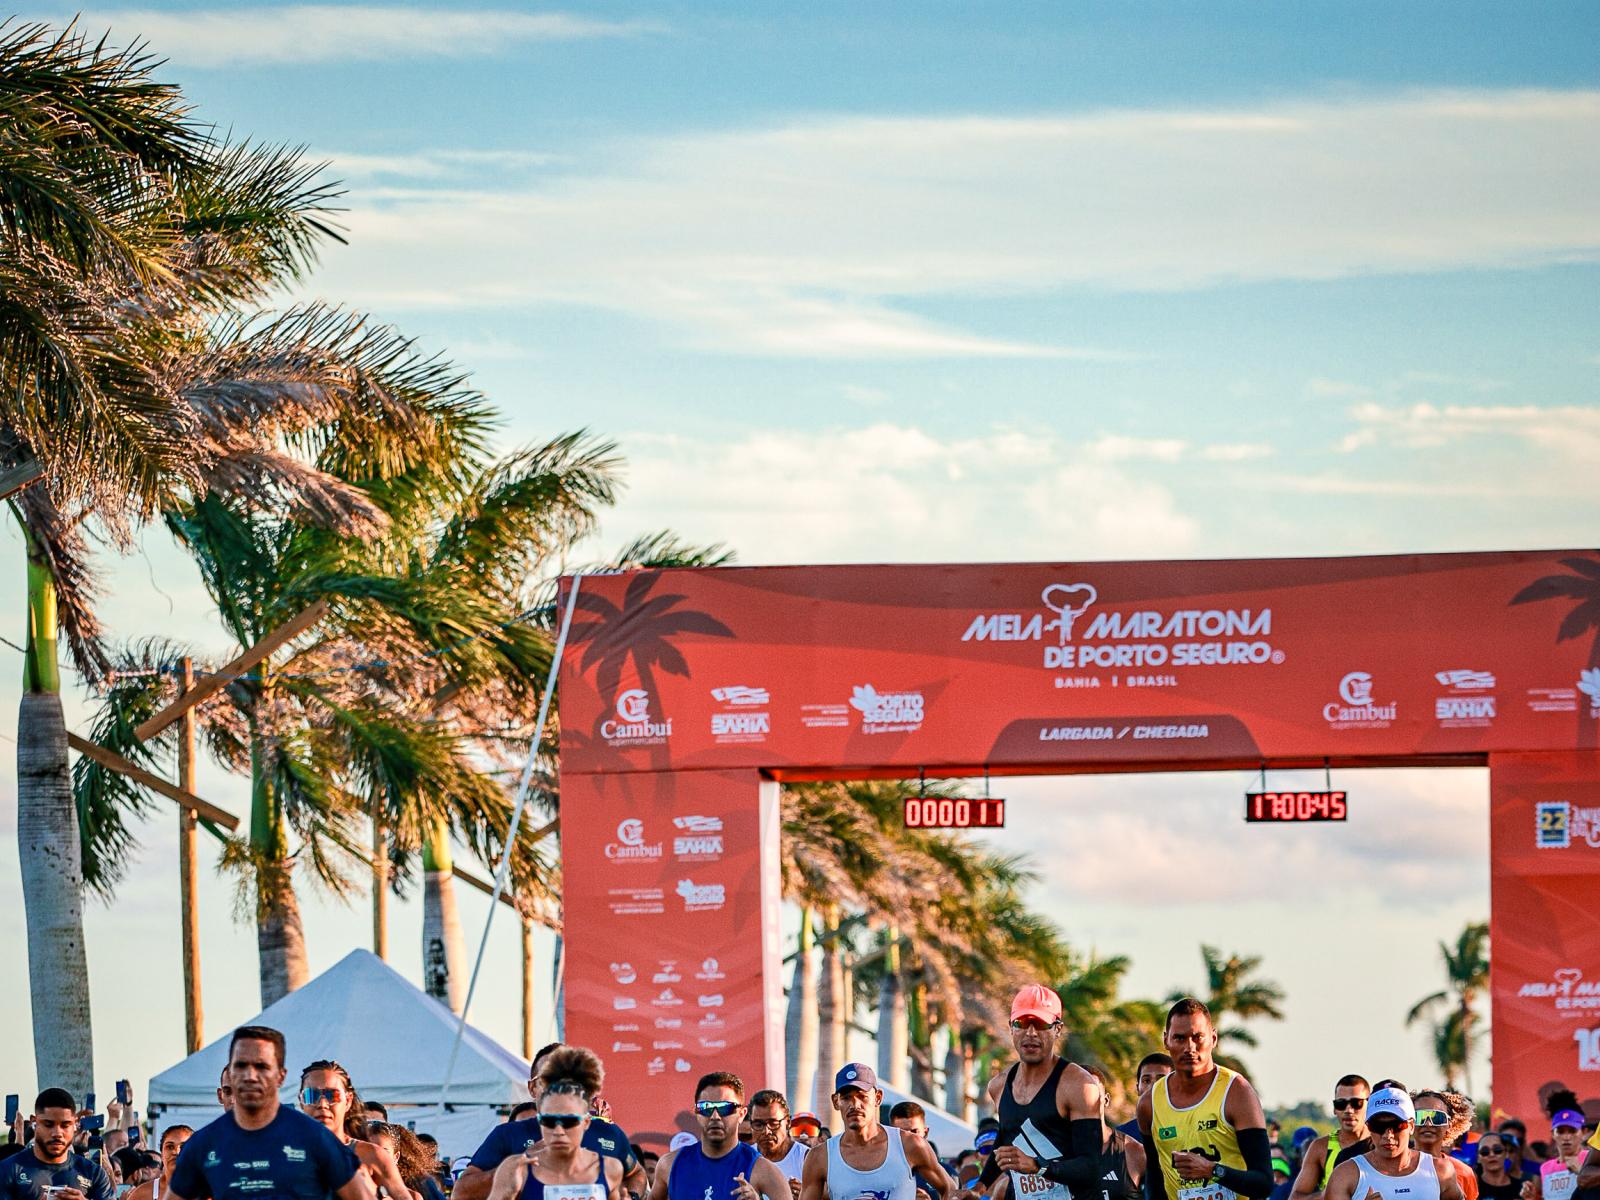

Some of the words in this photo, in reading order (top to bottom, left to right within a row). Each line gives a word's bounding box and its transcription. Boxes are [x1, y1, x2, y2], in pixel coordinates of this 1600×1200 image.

[962, 614, 1042, 641] MEIA
[1083, 609, 1272, 640] MARATONA
[1044, 646, 1075, 668] DE
[1078, 644, 1168, 667] PORTO
[1055, 677, 1100, 688] BAHIA
[1126, 675, 1178, 687] BRASIL
[1322, 701, 1397, 722] Cambuí
[600, 717, 673, 739] Cambuí
[1040, 727, 1113, 741] LARGADA
[1133, 725, 1209, 740] CHEGADA
[1254, 793, 1346, 820] 17:00:45
